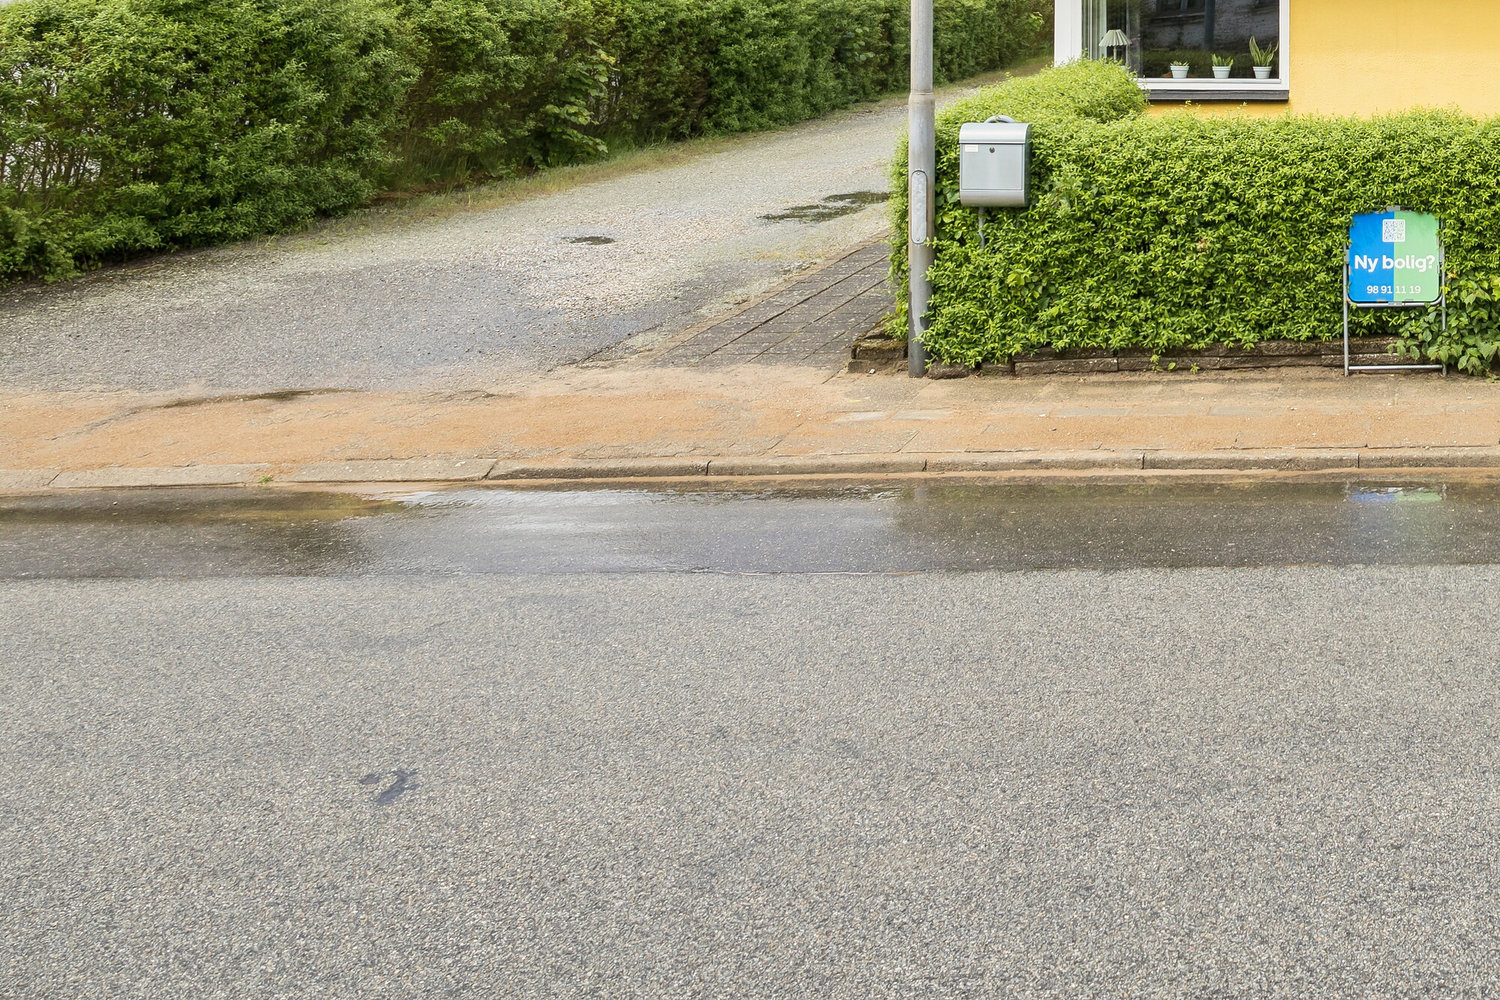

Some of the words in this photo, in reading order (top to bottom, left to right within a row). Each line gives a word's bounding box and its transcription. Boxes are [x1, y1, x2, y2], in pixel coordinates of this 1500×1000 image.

[1354, 255, 1379, 272] Ny
[1382, 255, 1436, 272] bolig?
[1366, 285, 1379, 294] 98
[1380, 285, 1393, 294] 91
[1395, 285, 1407, 294] 11
[1409, 285, 1421, 294] 19
